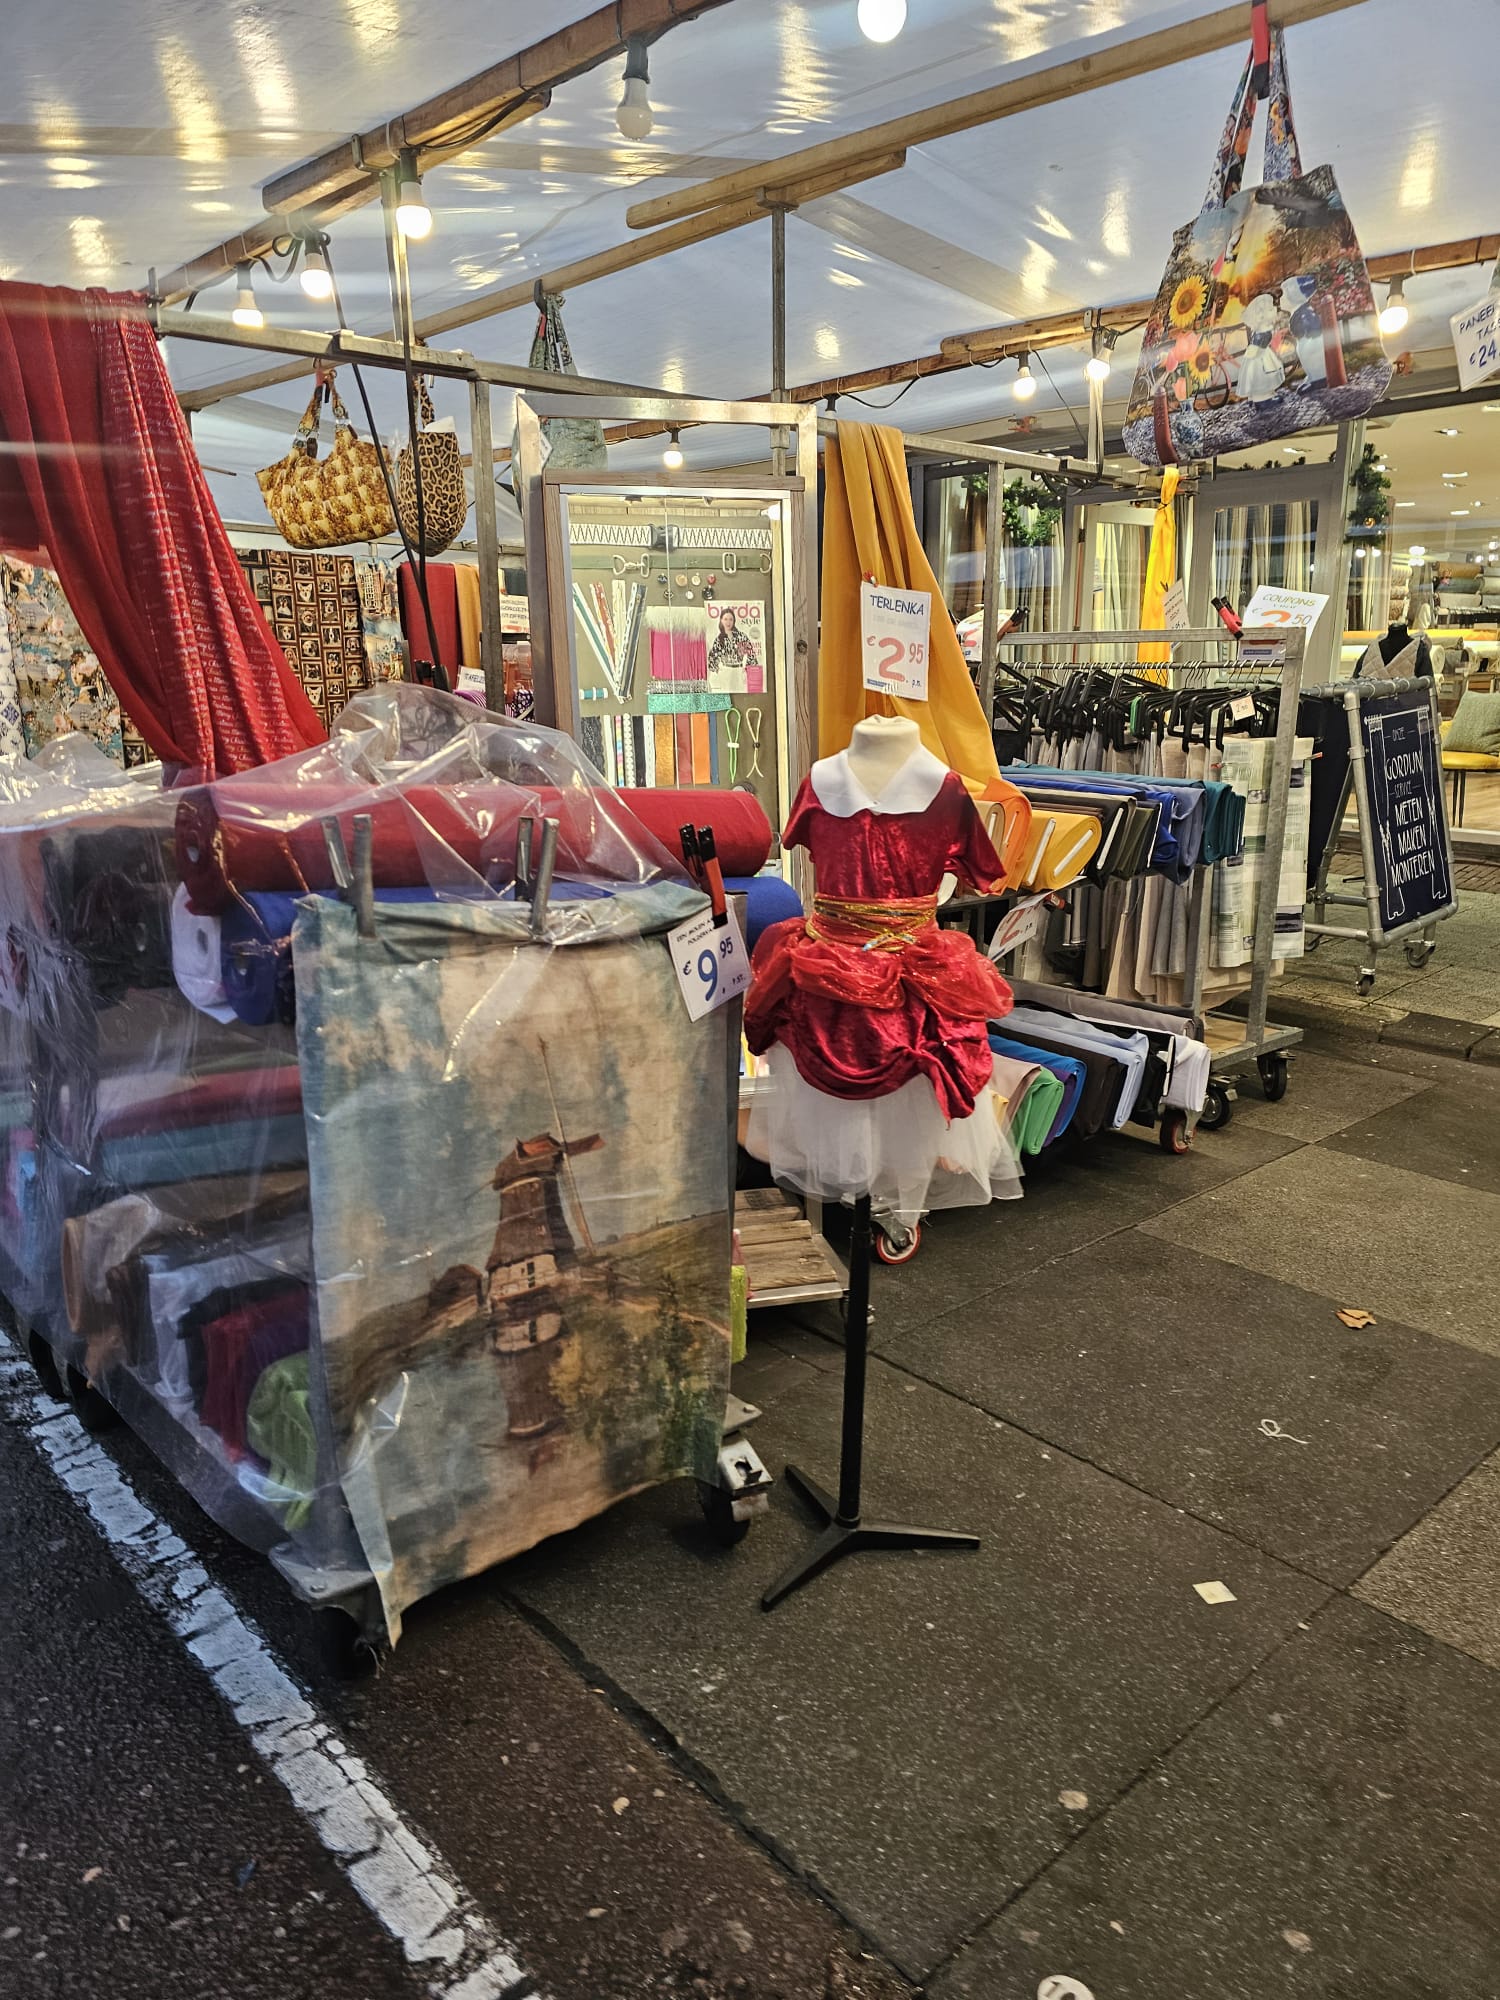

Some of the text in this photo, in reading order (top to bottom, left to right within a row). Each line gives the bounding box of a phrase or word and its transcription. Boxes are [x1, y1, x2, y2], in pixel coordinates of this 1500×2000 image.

[870, 595, 925, 616] TERLENKA
[1263, 593, 1316, 607] COUPONS
[740, 618, 761, 627] style
[1291, 613, 1312, 626] 50
[867, 636, 876, 647] €
[909, 643, 924, 665] 95
[1386, 751, 1423, 780] GORDIJN
[1395, 797, 1423, 828] METEN
[1398, 829, 1425, 857] MAKEN
[1391, 849, 1435, 888] MONTEREN
[683, 960, 692, 976] €
[719, 936, 733, 959] 95
